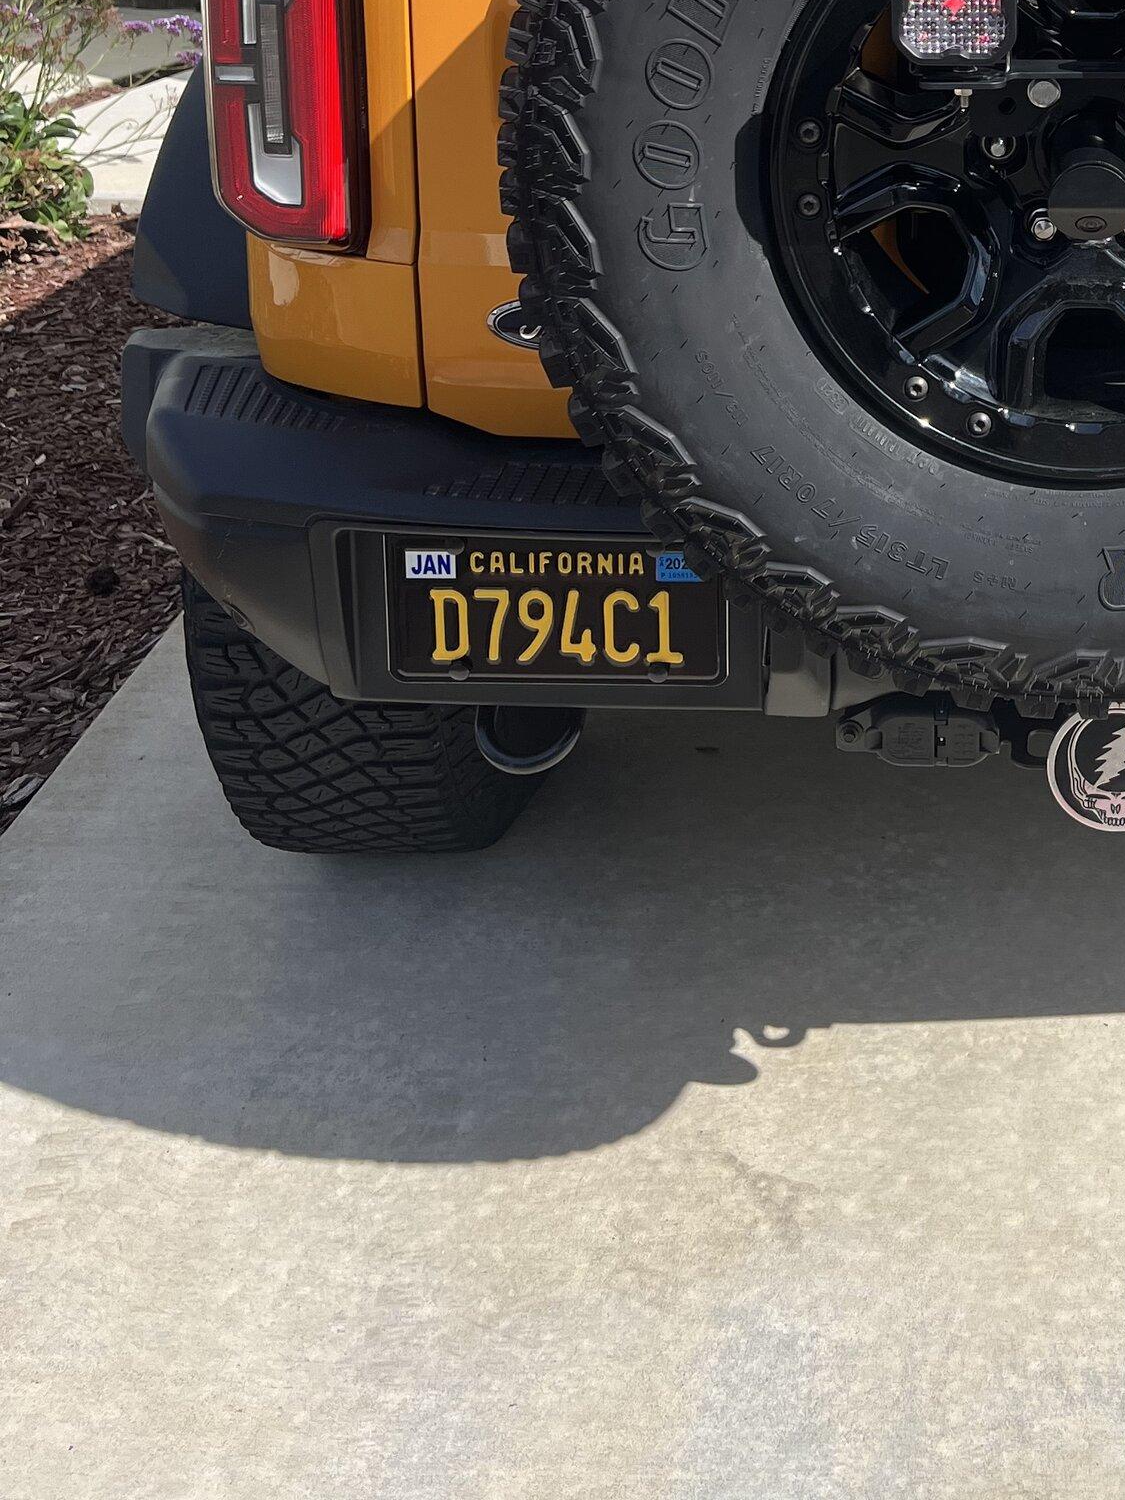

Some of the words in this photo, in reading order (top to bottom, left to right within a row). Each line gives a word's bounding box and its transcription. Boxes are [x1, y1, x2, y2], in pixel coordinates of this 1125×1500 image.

[750, 444, 950, 580] LT315/70R17
[411, 554, 450, 575] JAN
[469, 551, 644, 575] CALIFORNIA
[665, 557, 689, 570] 202
[429, 588, 684, 662] D794C1
